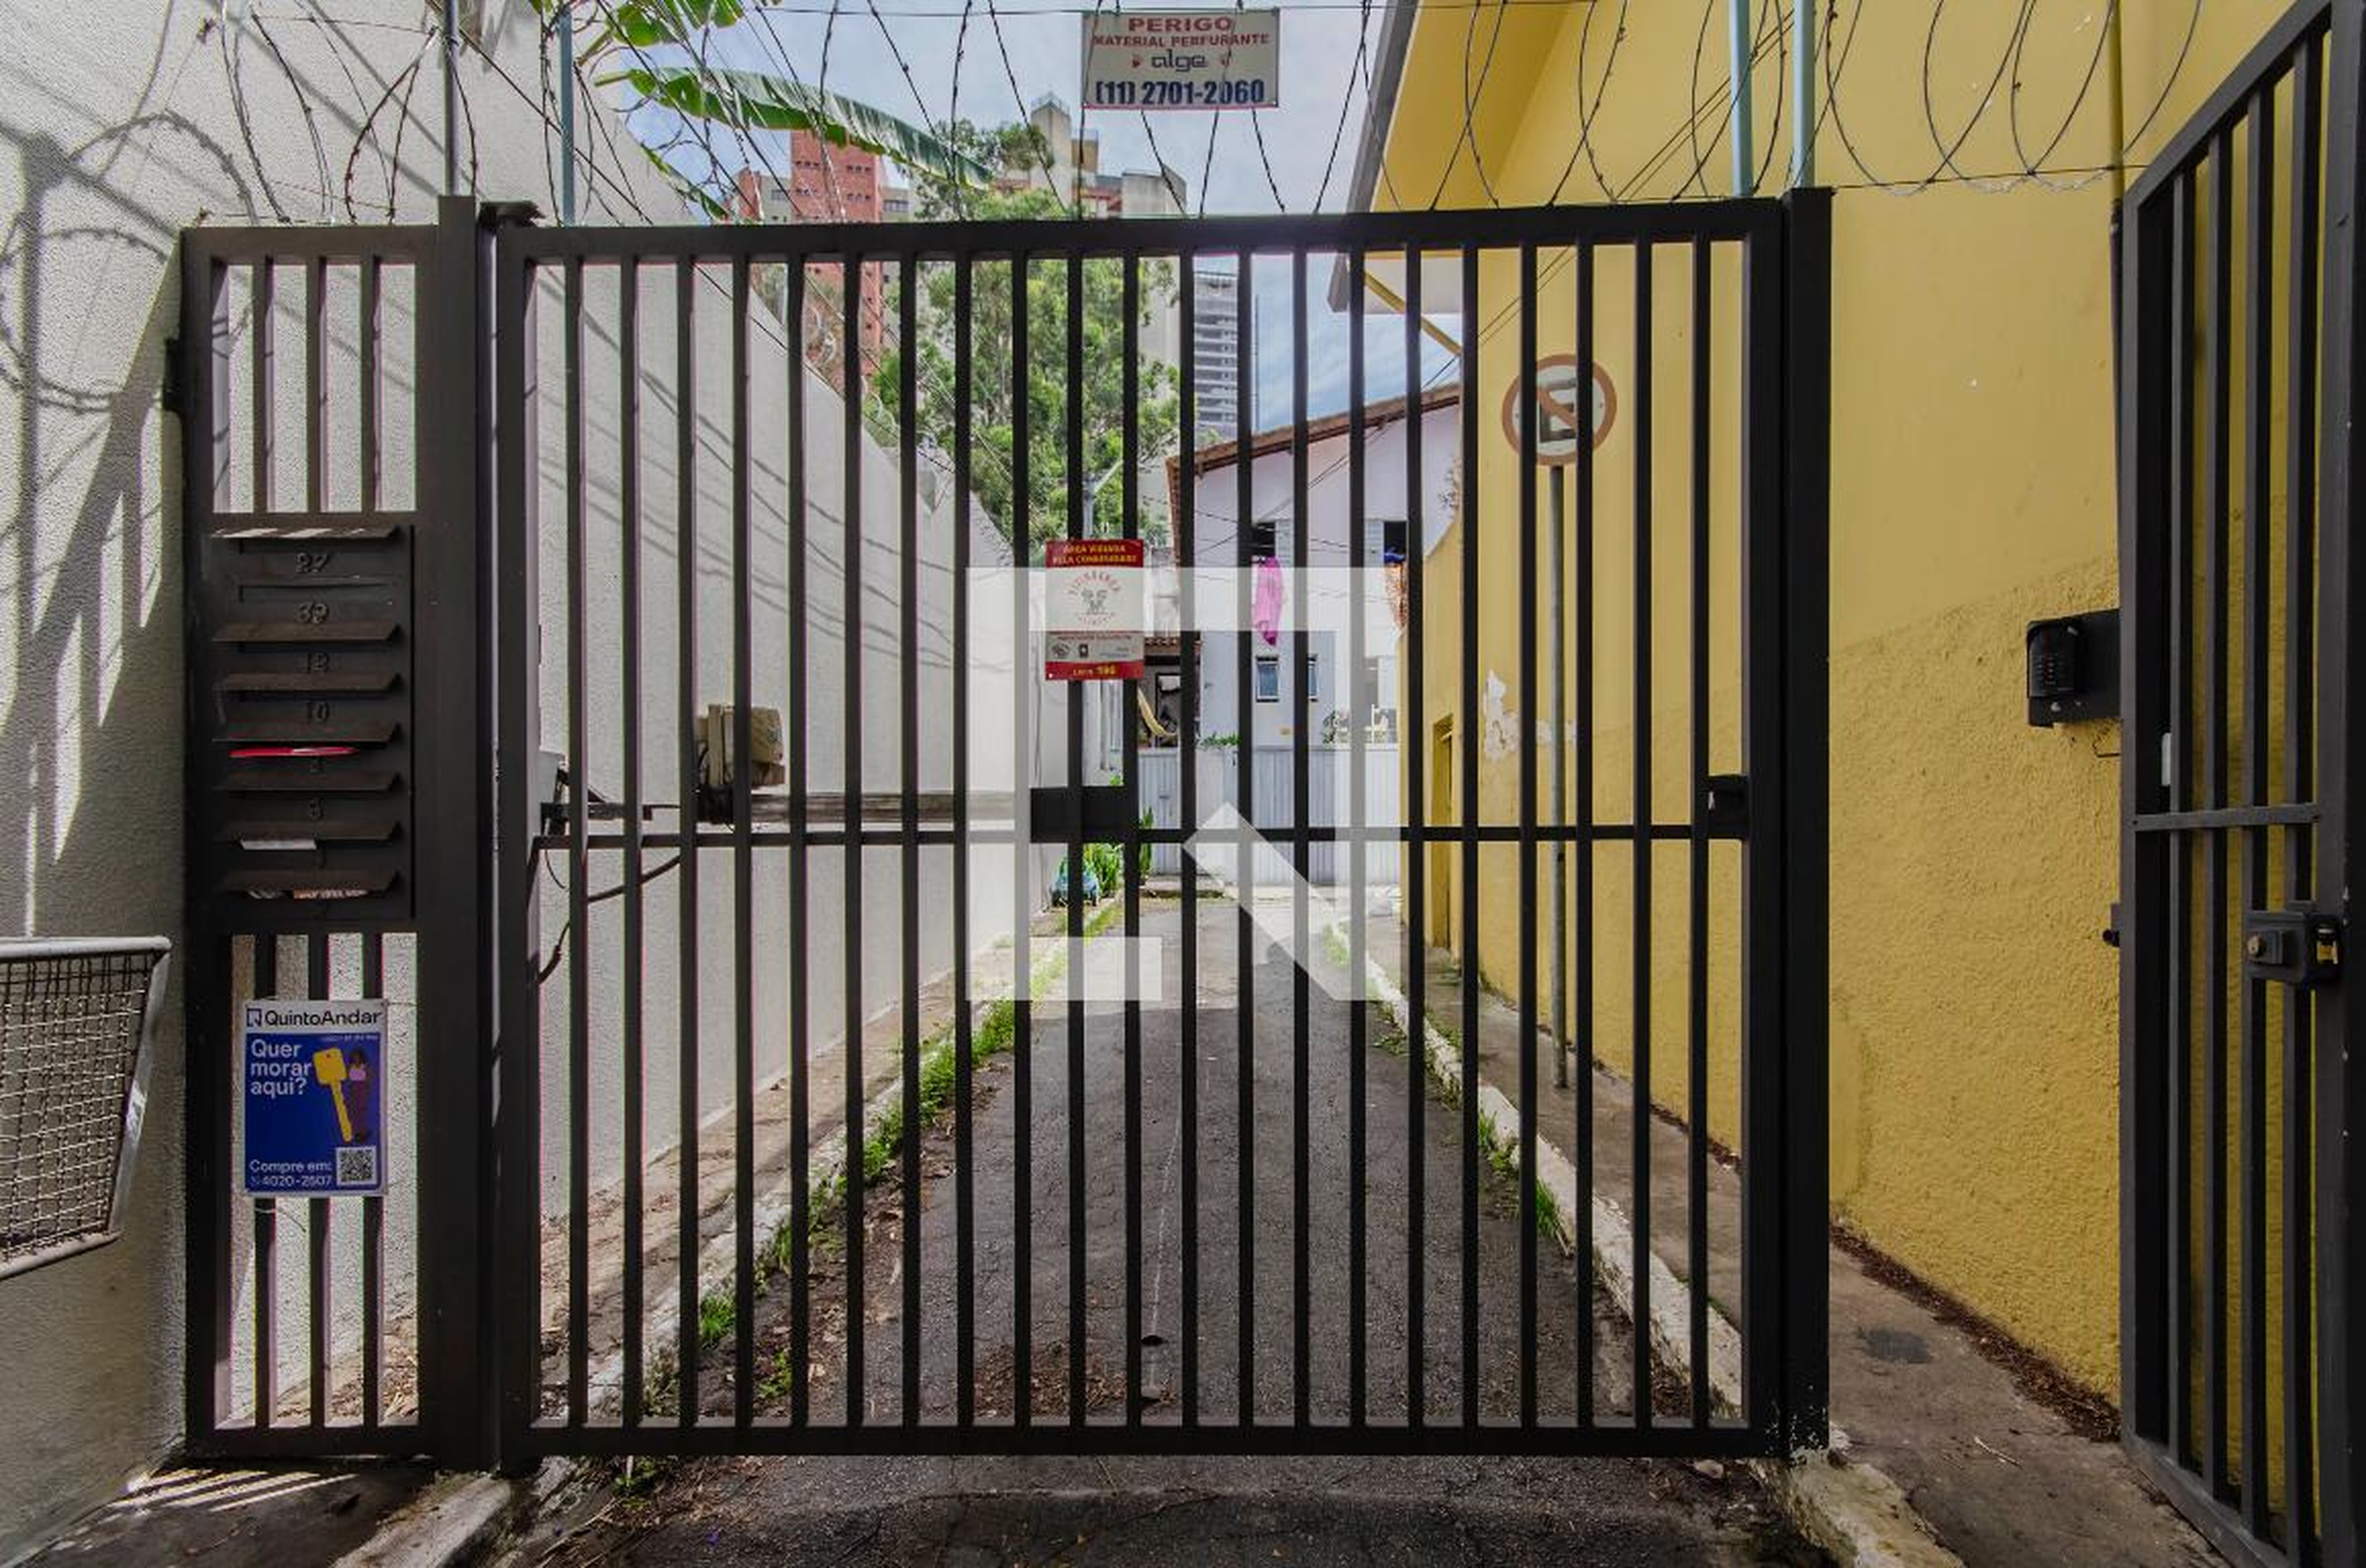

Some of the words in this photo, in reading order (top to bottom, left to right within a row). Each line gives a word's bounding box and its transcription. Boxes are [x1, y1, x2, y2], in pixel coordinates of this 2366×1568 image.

[1128, 16, 1232, 32] PERIGO
[1093, 34, 1166, 47] MATERIAL
[1171, 33, 1270, 47] PERFURANTE
[1096, 80, 1136, 105] (11)
[1142, 79, 1265, 105] 2701-2060
[264, 1009, 383, 1026] QuintoAndar
[251, 1038, 302, 1058] Quer
[250, 1061, 312, 1077] morar
[250, 1077, 307, 1099] aqui?
[249, 1158, 304, 1174] Compre
